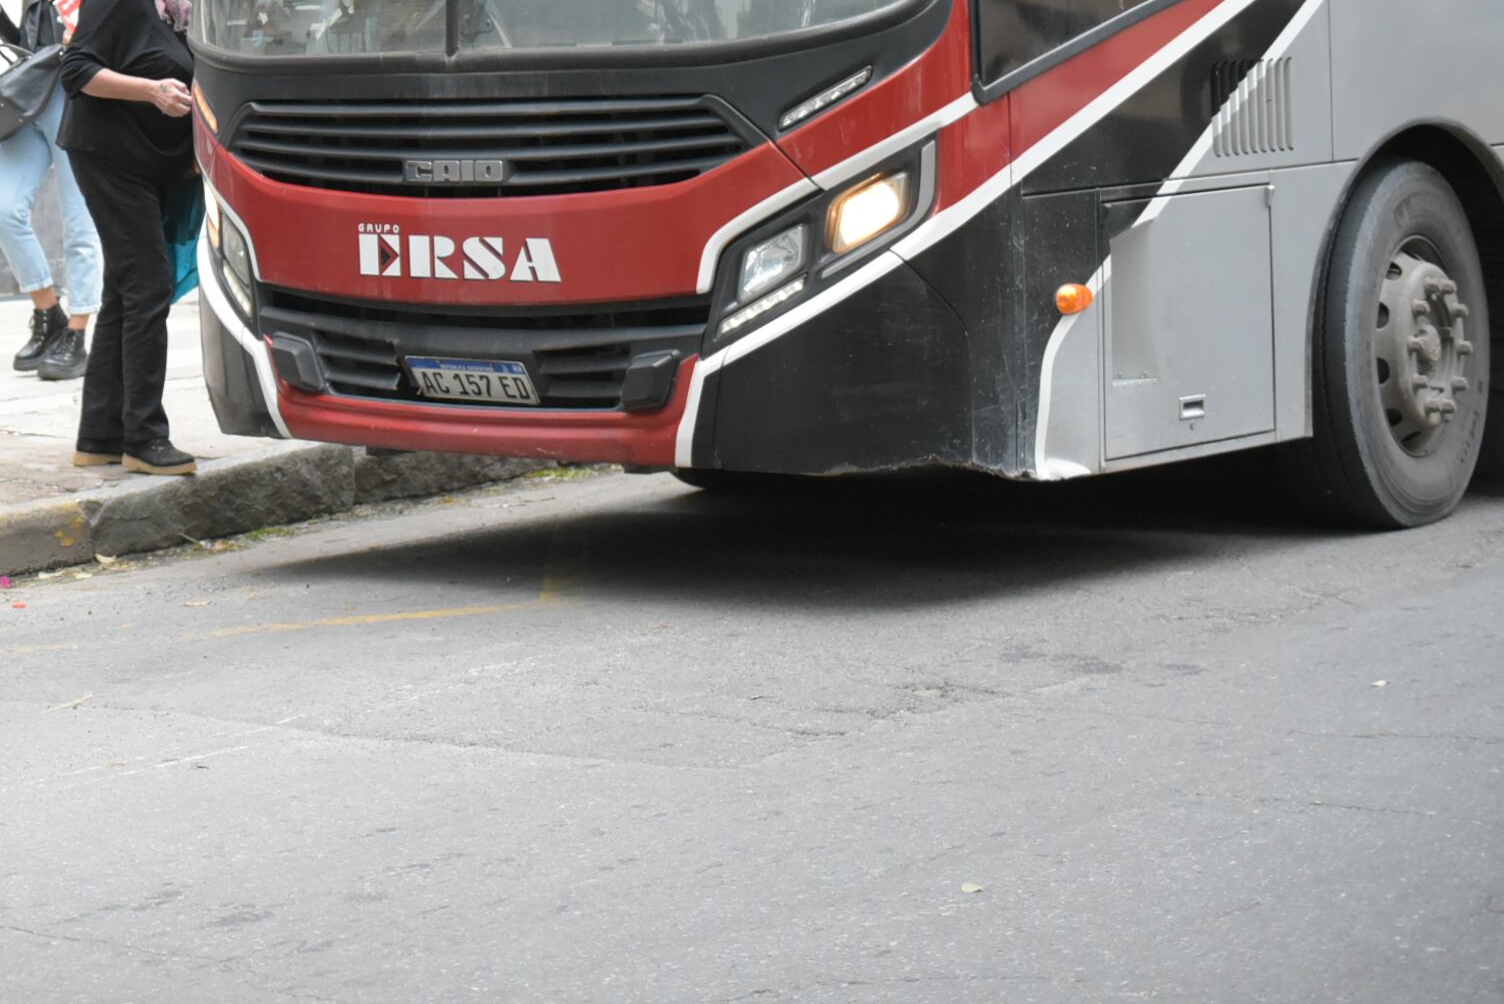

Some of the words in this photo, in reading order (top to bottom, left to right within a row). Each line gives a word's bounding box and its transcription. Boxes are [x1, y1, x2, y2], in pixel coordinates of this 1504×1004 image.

[405, 160, 503, 182] CAIO
[358, 222, 400, 234] GRUPO
[358, 233, 561, 282] ERSA
[421, 371, 450, 394] AC
[453, 373, 492, 397] 157
[497, 376, 531, 400] ED
